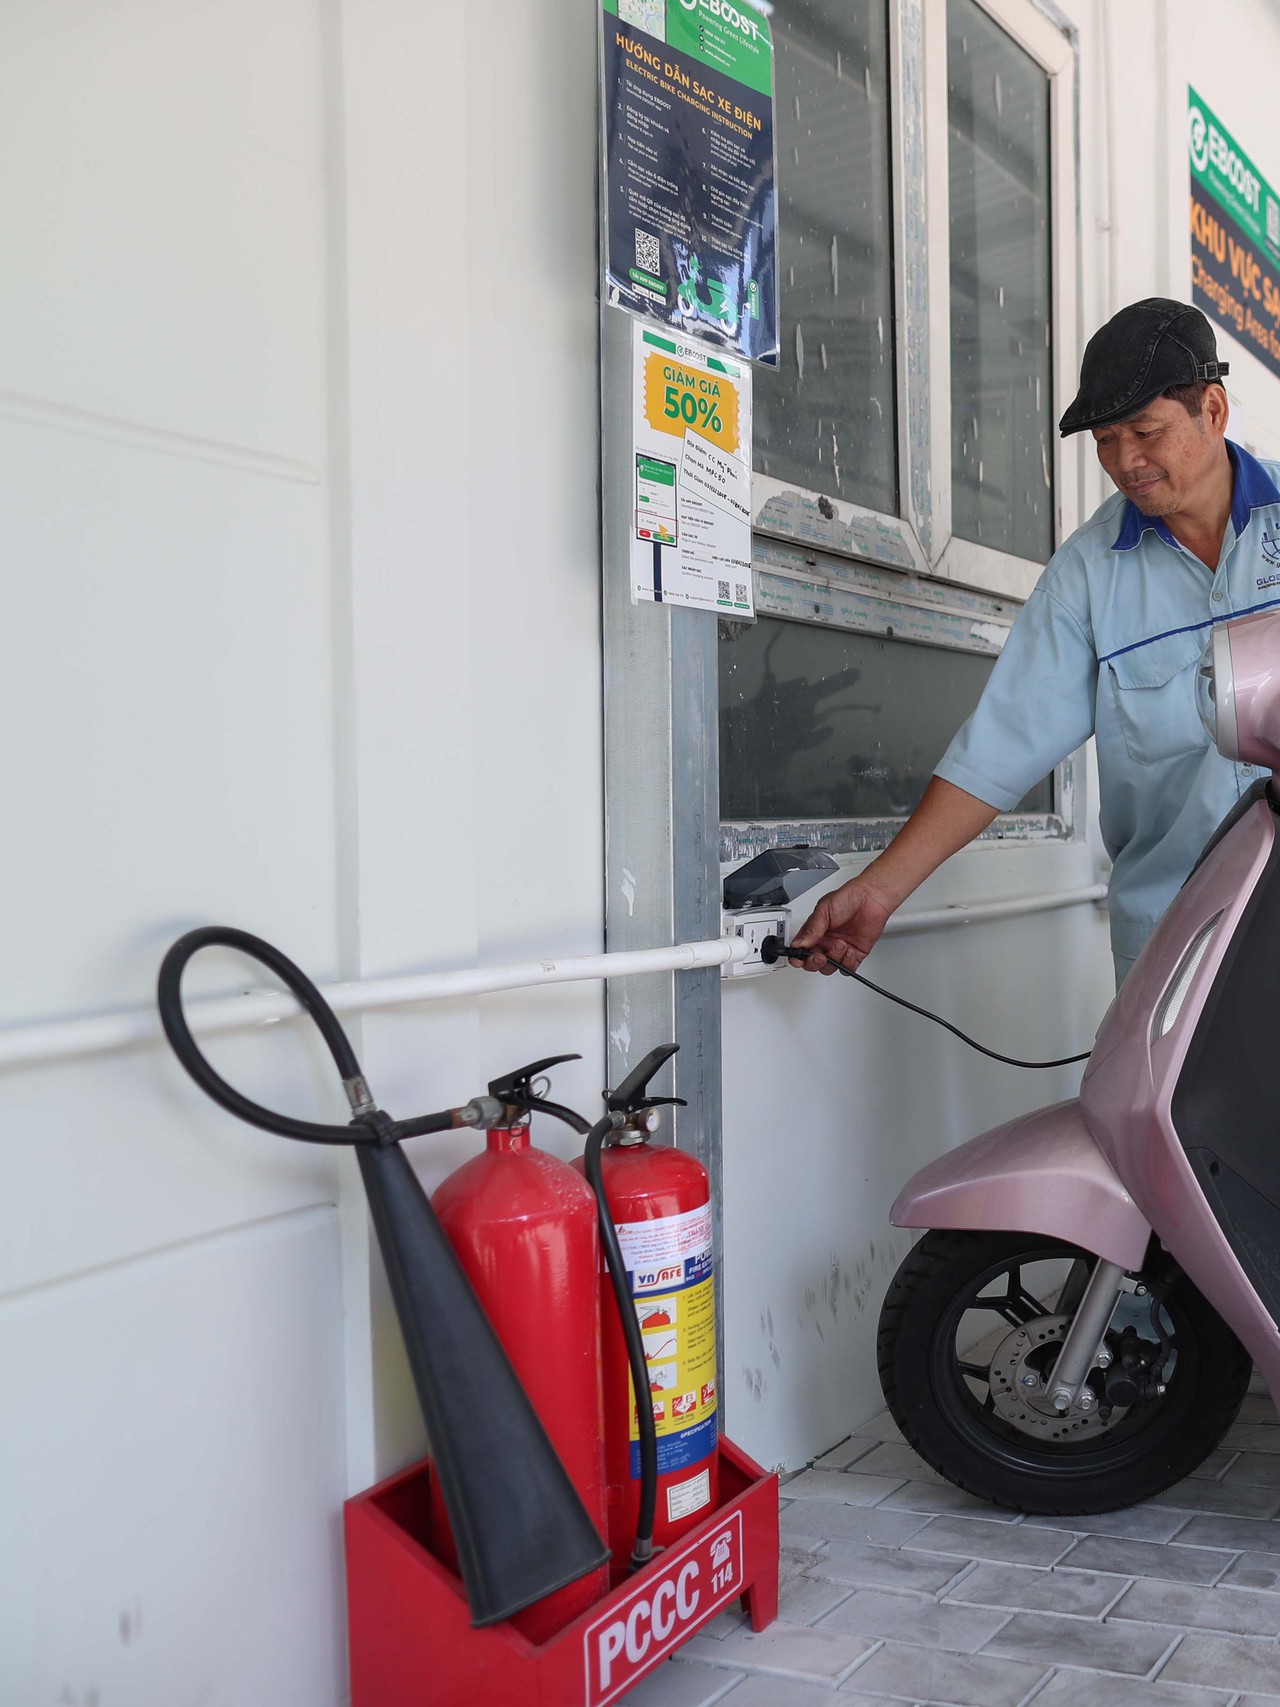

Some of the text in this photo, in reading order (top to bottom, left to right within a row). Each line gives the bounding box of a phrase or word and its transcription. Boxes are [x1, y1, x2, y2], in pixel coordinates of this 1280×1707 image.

[699, 10, 722, 32] Powering
[723, 27, 739, 41] Green
[740, 37, 760, 55] Lifestyle
[616, 32, 762, 131] HƯỚNG DẪN SẠC XE ĐIỆN
[626, 58, 753, 140] ELECTRIC BIKE CHARGING INSTRUCTION
[1191, 197, 1226, 264] KHU
[1229, 237, 1262, 301] VỰC
[1192, 254, 1244, 331] Charging
[1245, 308, 1269, 349] Area
[663, 366, 721, 398] GIẢM GIÁ
[664, 385, 723, 433] 50%
[779, 924, 783, 932] 3
[686, 1393, 694, 1403] B
[711, 1562, 733, 1594] 114
[599, 1561, 699, 1692] PCCC
